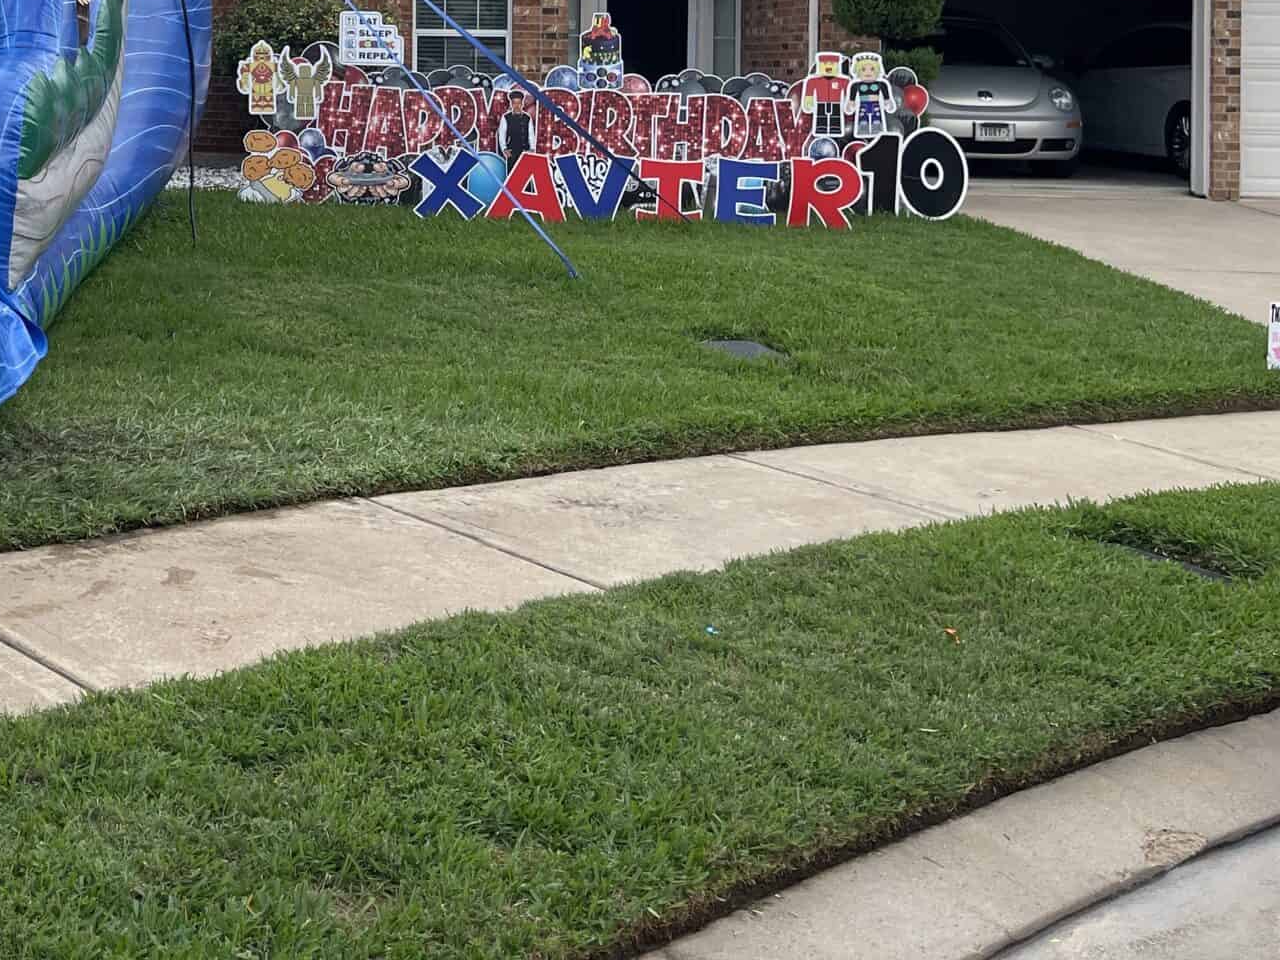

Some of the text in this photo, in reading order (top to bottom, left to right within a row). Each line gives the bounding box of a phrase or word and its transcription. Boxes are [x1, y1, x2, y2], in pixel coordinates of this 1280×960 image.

[359, 52, 398, 60] REPEAT
[316, 81, 817, 162] HAPPY BIRTHDAY
[408, 147, 864, 230] XAVIER
[855, 126, 969, 221] 10
